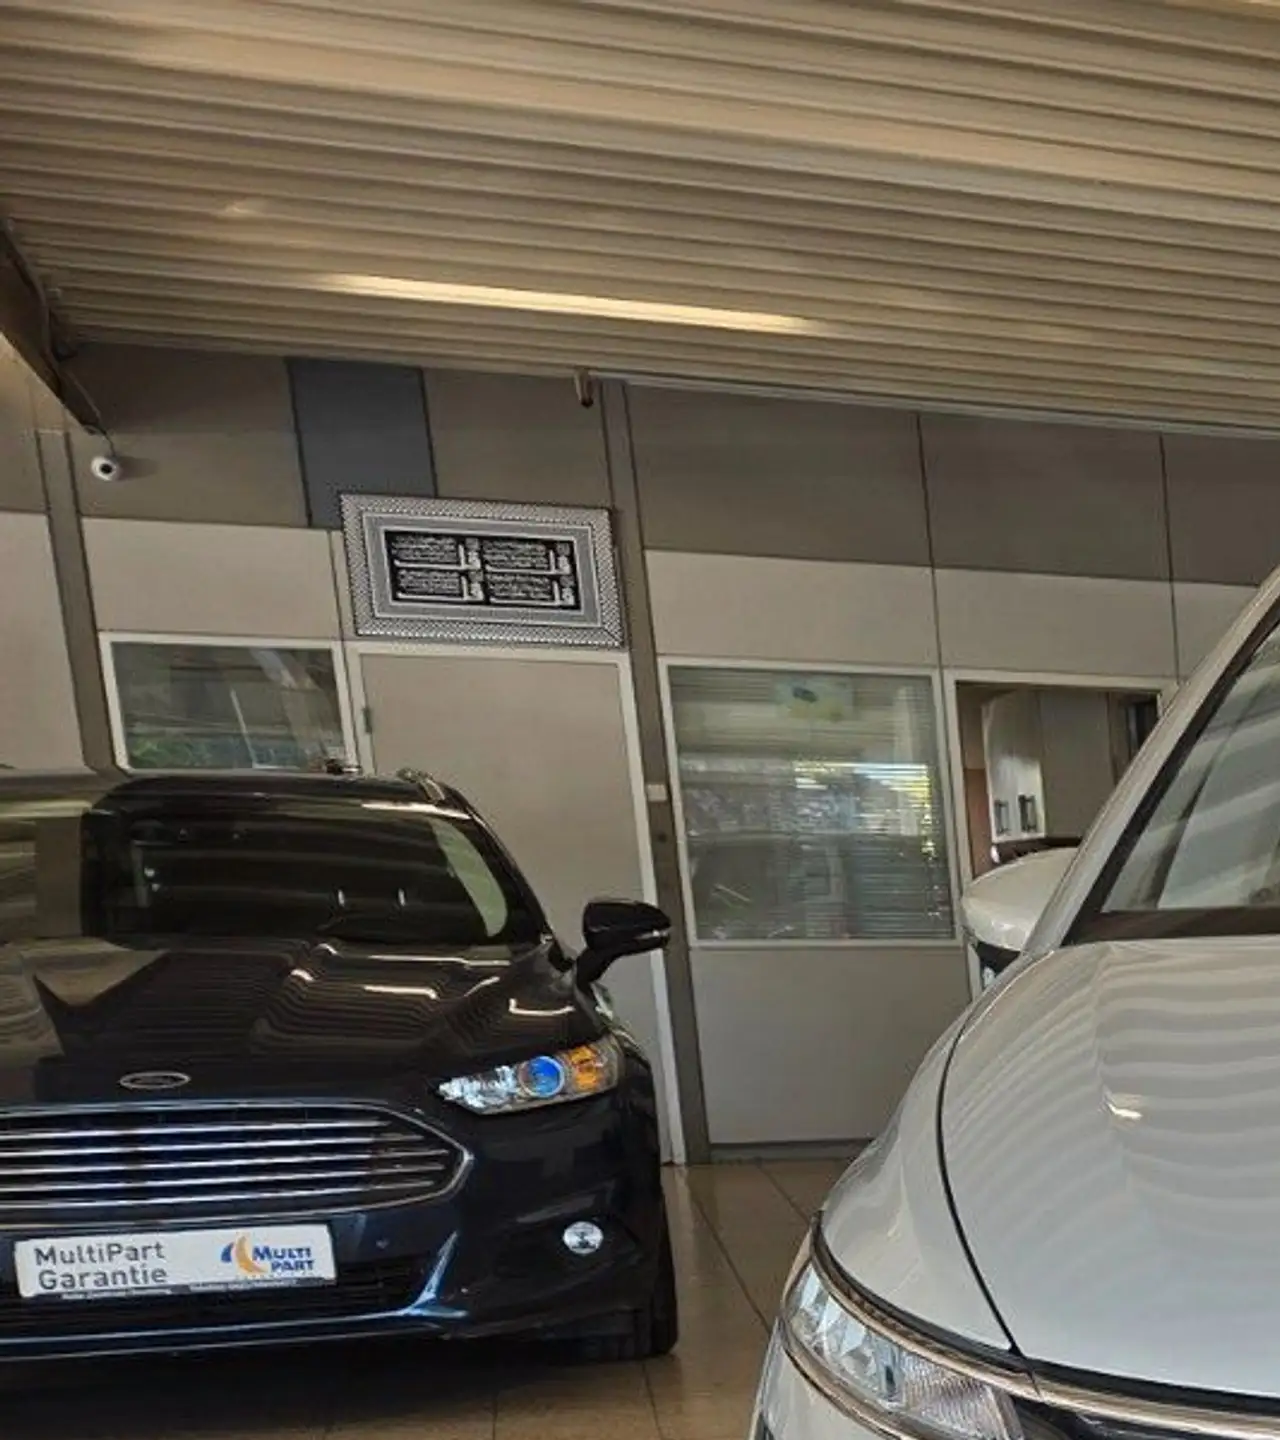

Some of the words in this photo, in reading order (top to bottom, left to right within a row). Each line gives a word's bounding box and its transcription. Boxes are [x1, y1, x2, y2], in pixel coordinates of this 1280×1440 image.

[34, 1241, 165, 1266] MultiPart
[252, 1246, 312, 1261] MULTI
[38, 1264, 168, 1291] Garantie
